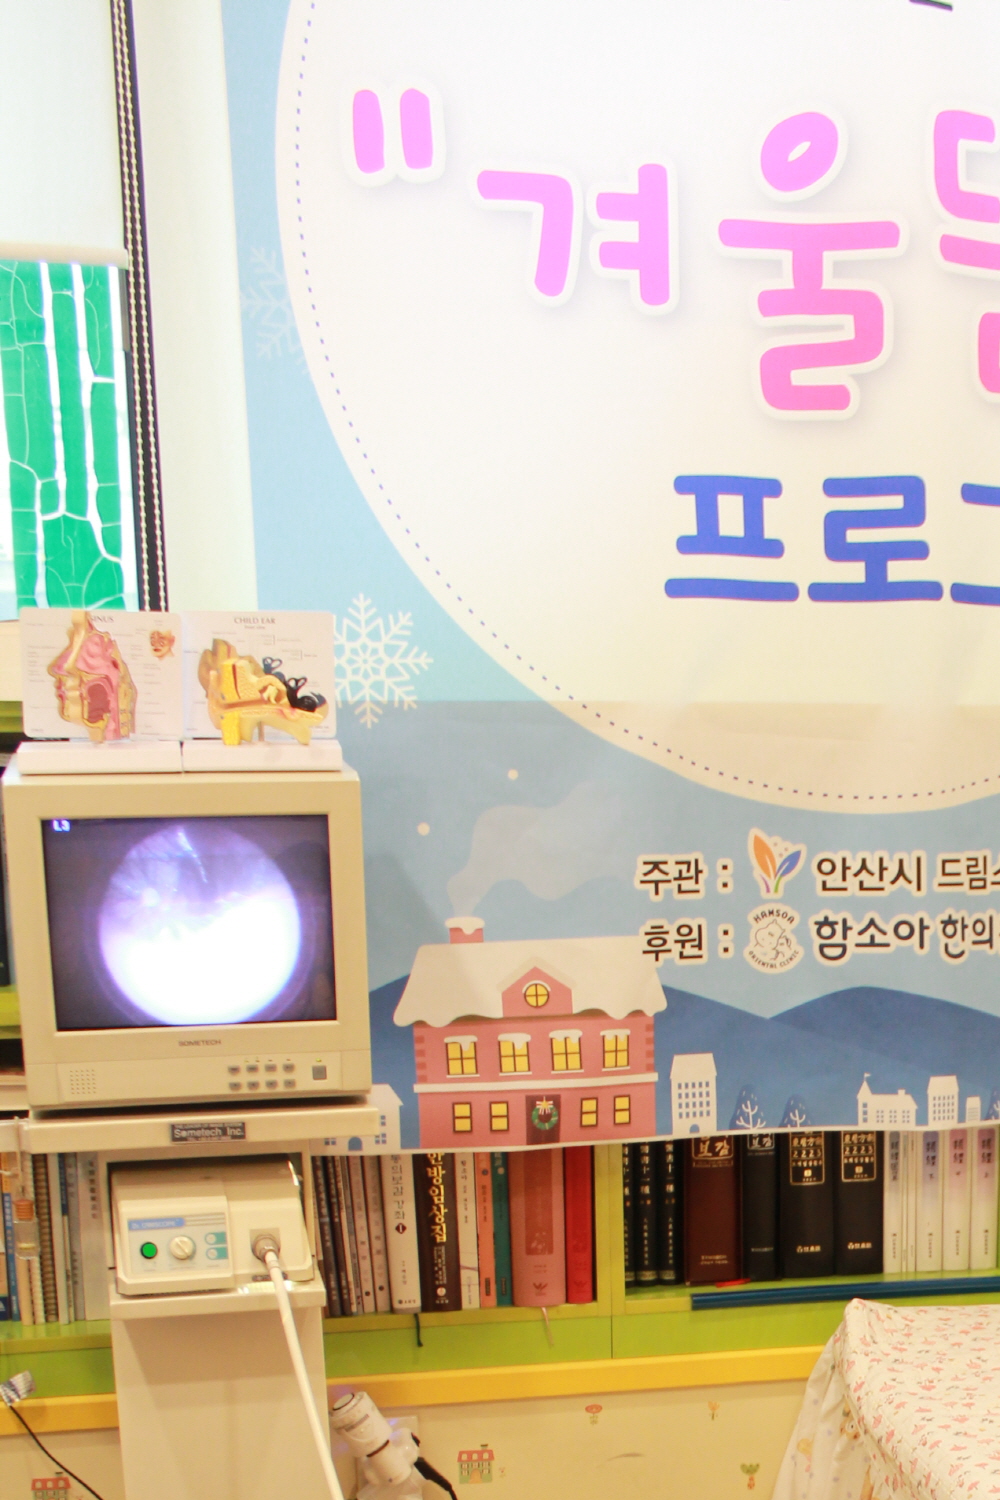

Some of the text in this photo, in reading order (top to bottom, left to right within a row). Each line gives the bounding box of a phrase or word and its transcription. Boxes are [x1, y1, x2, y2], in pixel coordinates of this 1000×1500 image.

[639, 859, 703, 896] 주관
[816, 857, 923, 893] 안산시
[753, 908, 795, 924] HAMSOA
[642, 922, 704, 961] 후원
[814, 915, 930, 961] 함소아
